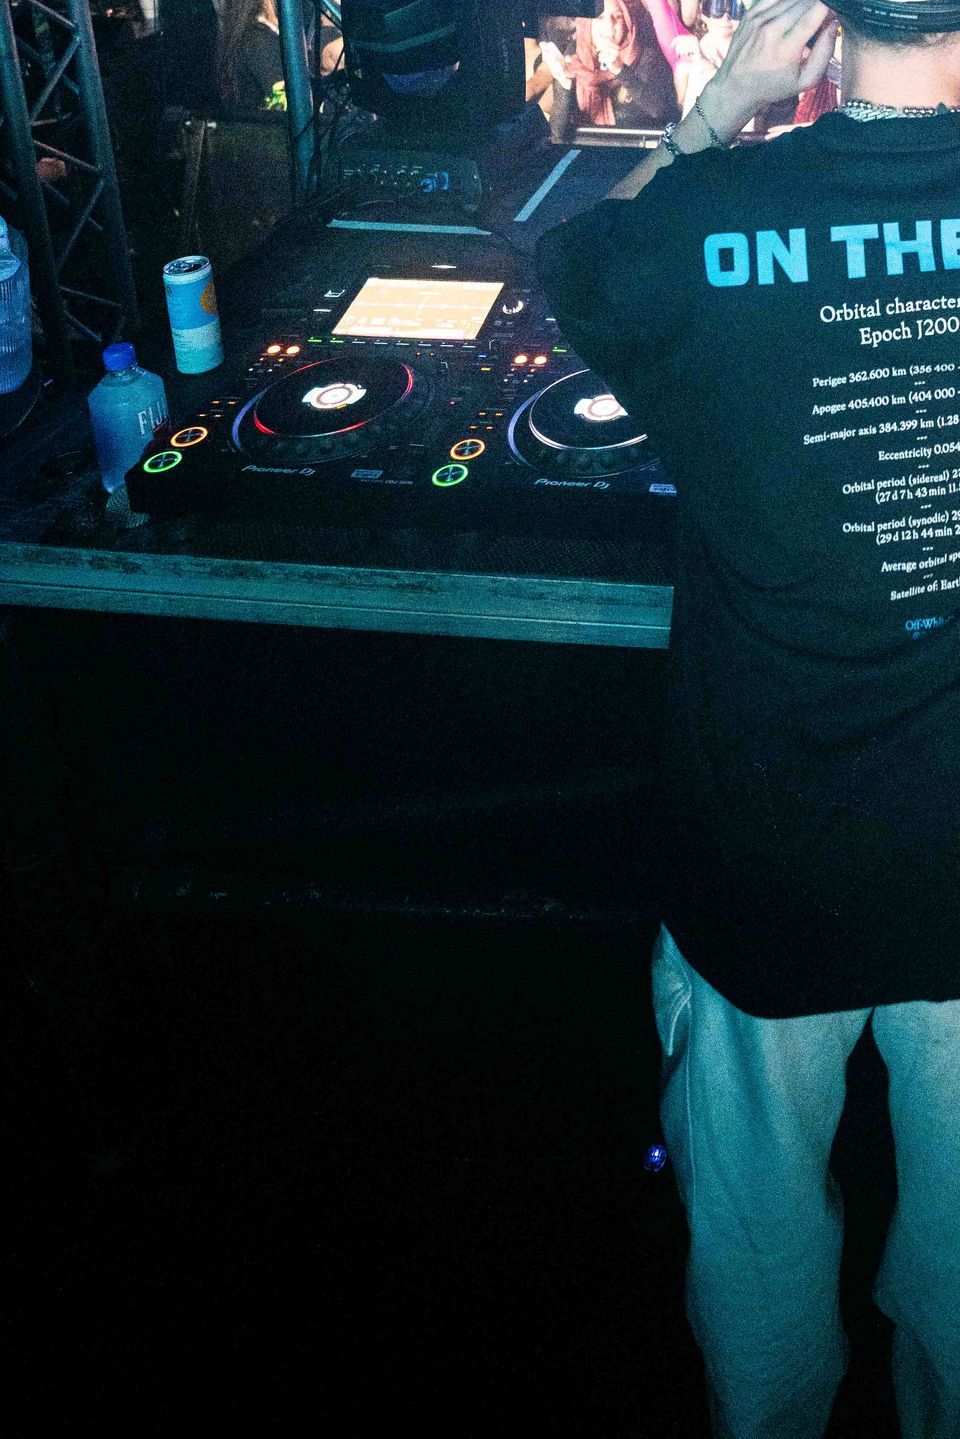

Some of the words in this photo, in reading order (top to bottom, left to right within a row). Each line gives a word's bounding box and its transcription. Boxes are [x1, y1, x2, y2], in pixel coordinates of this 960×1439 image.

[704, 228, 809, 287] ON
[819, 299, 881, 324] Orbital
[860, 322, 912, 348] Epoch
[812, 375, 847, 388] Perigee
[849, 368, 890, 383] 362.600
[892, 367, 907, 377] km
[909, 363, 932, 376] (356
[934, 363, 955, 373] 400
[811, 402, 847, 416] Apogee
[891, 394, 906, 405] km
[908, 391, 932, 404] (404
[934, 388, 955, 400] 000
[803, 428, 856, 446] Semi-major
[858, 425, 877, 437] axis
[879, 419, 918, 434] 384.399
[920, 418, 934, 429] km
[878, 445, 932, 461] Eccentricity
[241, 464, 298, 475] Pioneer
[534, 478, 592, 487] Pioneer
[842, 480, 875, 494] Orbital
[876, 476, 906, 491] period
[908, 470, 950, 487] (sidereal)
[842, 520, 875, 534] Orbital
[876, 517, 906, 533] period
[908, 510, 950, 528] (synodic)
[881, 561, 917, 573] Average
[919, 553, 947, 569] orbital
[890, 586, 925, 601] Satellite
